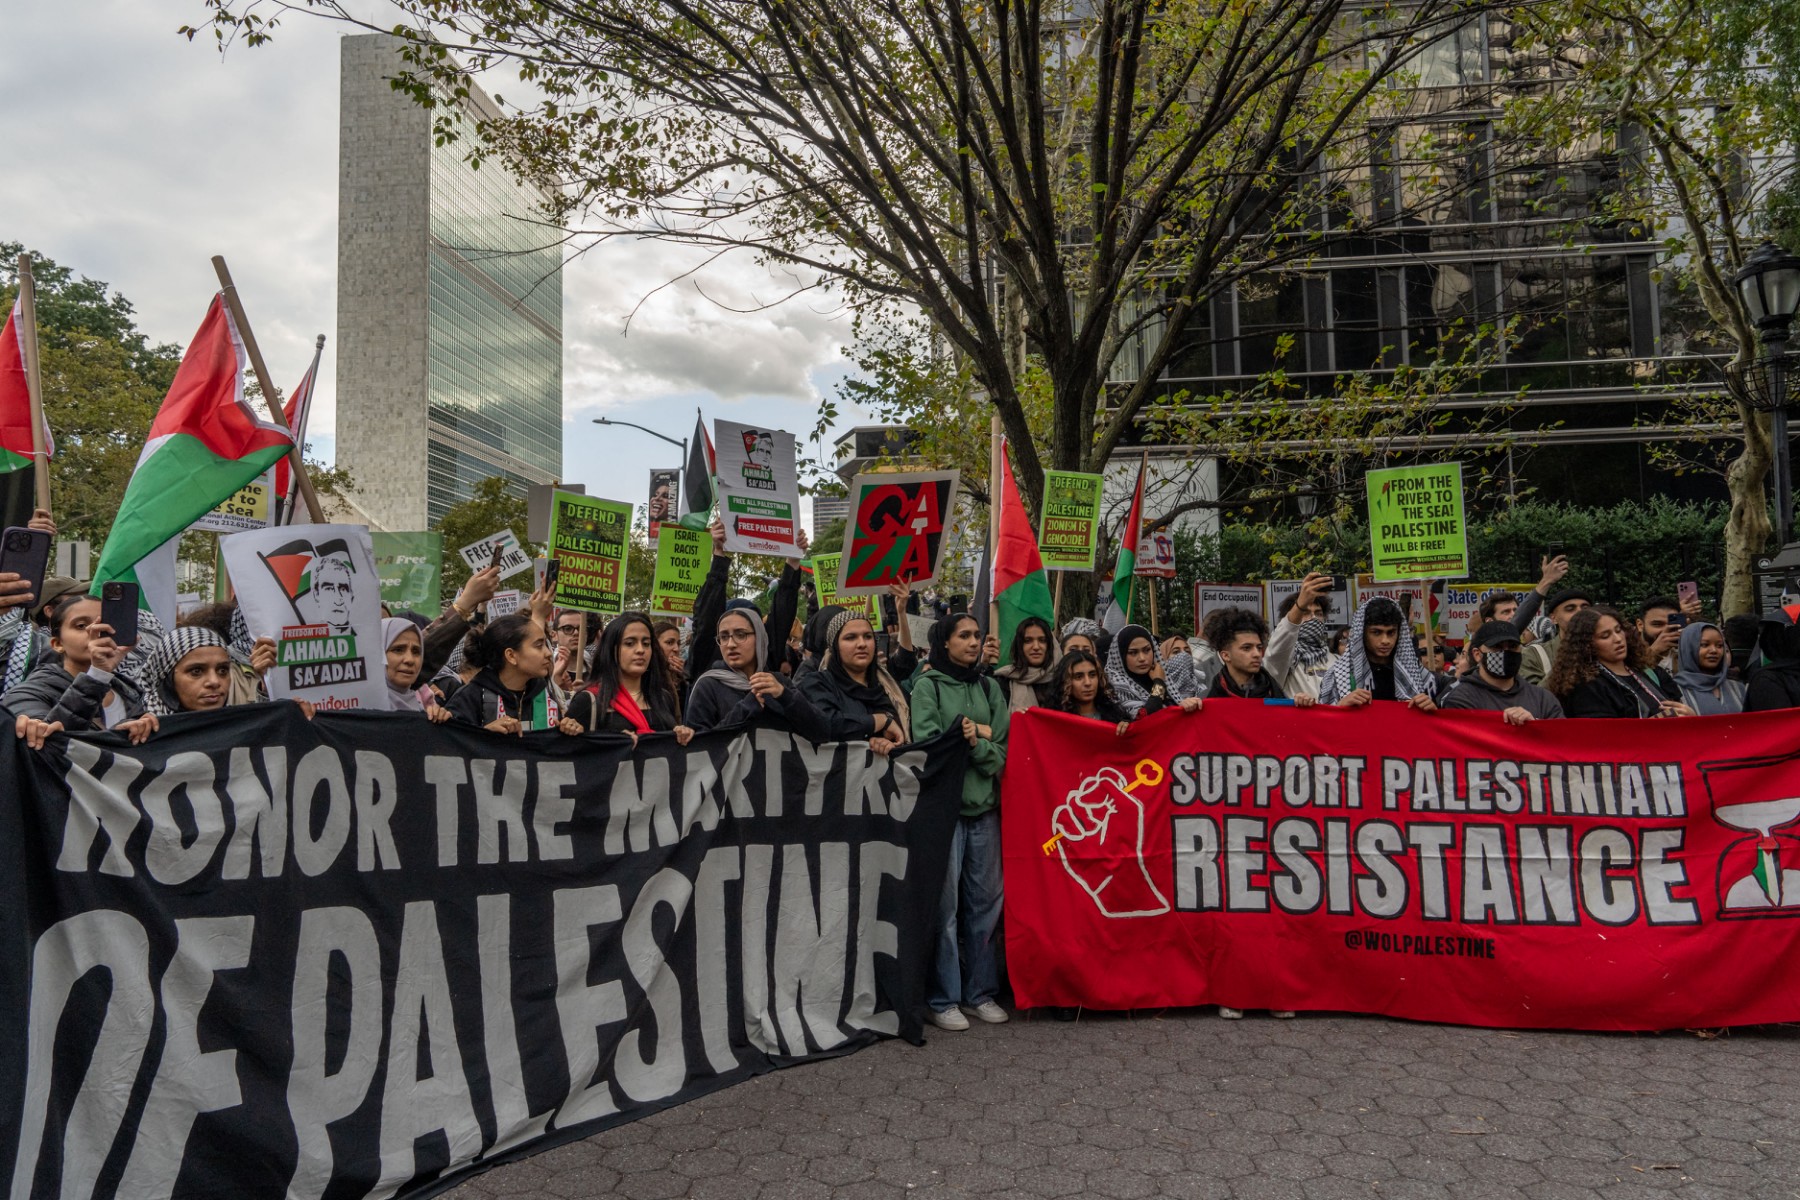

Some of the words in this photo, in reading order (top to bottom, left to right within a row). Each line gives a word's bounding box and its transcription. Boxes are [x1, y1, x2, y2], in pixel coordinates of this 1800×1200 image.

[744, 469, 769, 478] AHMAD
[1055, 476, 1089, 490] DEFEND
[1391, 477, 1425, 492] FROM
[1428, 475, 1452, 489] THE
[240, 494, 256, 505] to
[1397, 491, 1432, 506] RIVER
[1435, 490, 1453, 502] TO
[226, 503, 254, 517] Sea
[567, 503, 616, 524] DEFEND
[1047, 503, 1093, 516] PALESTINE!
[1402, 507, 1424, 519] THE
[1426, 504, 1454, 518] SEA!
[224, 514, 245, 522] Action
[246, 517, 267, 526] Center
[1047, 519, 1076, 531] ZIONISM
[1079, 521, 1087, 532] IS
[674, 530, 700, 542] ISRAEL:
[738, 522, 755, 531] FREE
[756, 524, 792, 536] PALESTINE!
[1381, 520, 1457, 539] PALESTINE
[556, 534, 622, 557] PALESTINE!
[1046, 533, 1085, 545] GENOCIDE!
[1383, 543, 1405, 553] WILL
[1407, 541, 1419, 551] BE
[1420, 539, 1446, 550] FREE!
[465, 541, 495, 564] FREE
[674, 545, 699, 555] RACIST
[396, 555, 427, 565] Free
[557, 554, 601, 574] ZIONISM
[603, 562, 614, 575] IS
[670, 557, 691, 567] TOOL
[691, 559, 701, 568] OF
[824, 558, 840, 569] DEF
[558, 570, 612, 591] GENOCIDE!
[678, 570, 692, 580] U.S.
[565, 586, 620, 601] WORKERS.ORG
[1273, 584, 1294, 593] Israel
[1203, 593, 1217, 601] End
[1218, 593, 1259, 603] Occupation
[1448, 589, 1478, 604] State
[578, 599, 598, 608] WORLD
[600, 602, 619, 611] PARTY
[284, 629, 313, 638] FREEDOM
[315, 627, 327, 636] FOR
[283, 638, 349, 662] AHMAD
[294, 660, 362, 687] SA'ADAT
[1170, 752, 1367, 808] SUPPORT
[1381, 756, 1689, 818] PALESTINIAN
[56, 738, 402, 885] HONOR
[424, 755, 577, 867] THE
[603, 728, 928, 856] MARTYRS
[1170, 814, 1702, 927] RESISTANCE
[1344, 930, 1496, 959] @WOLPALESTINE
[9, 906, 256, 1200] OF
[285, 841, 909, 1200] PALESTINE
